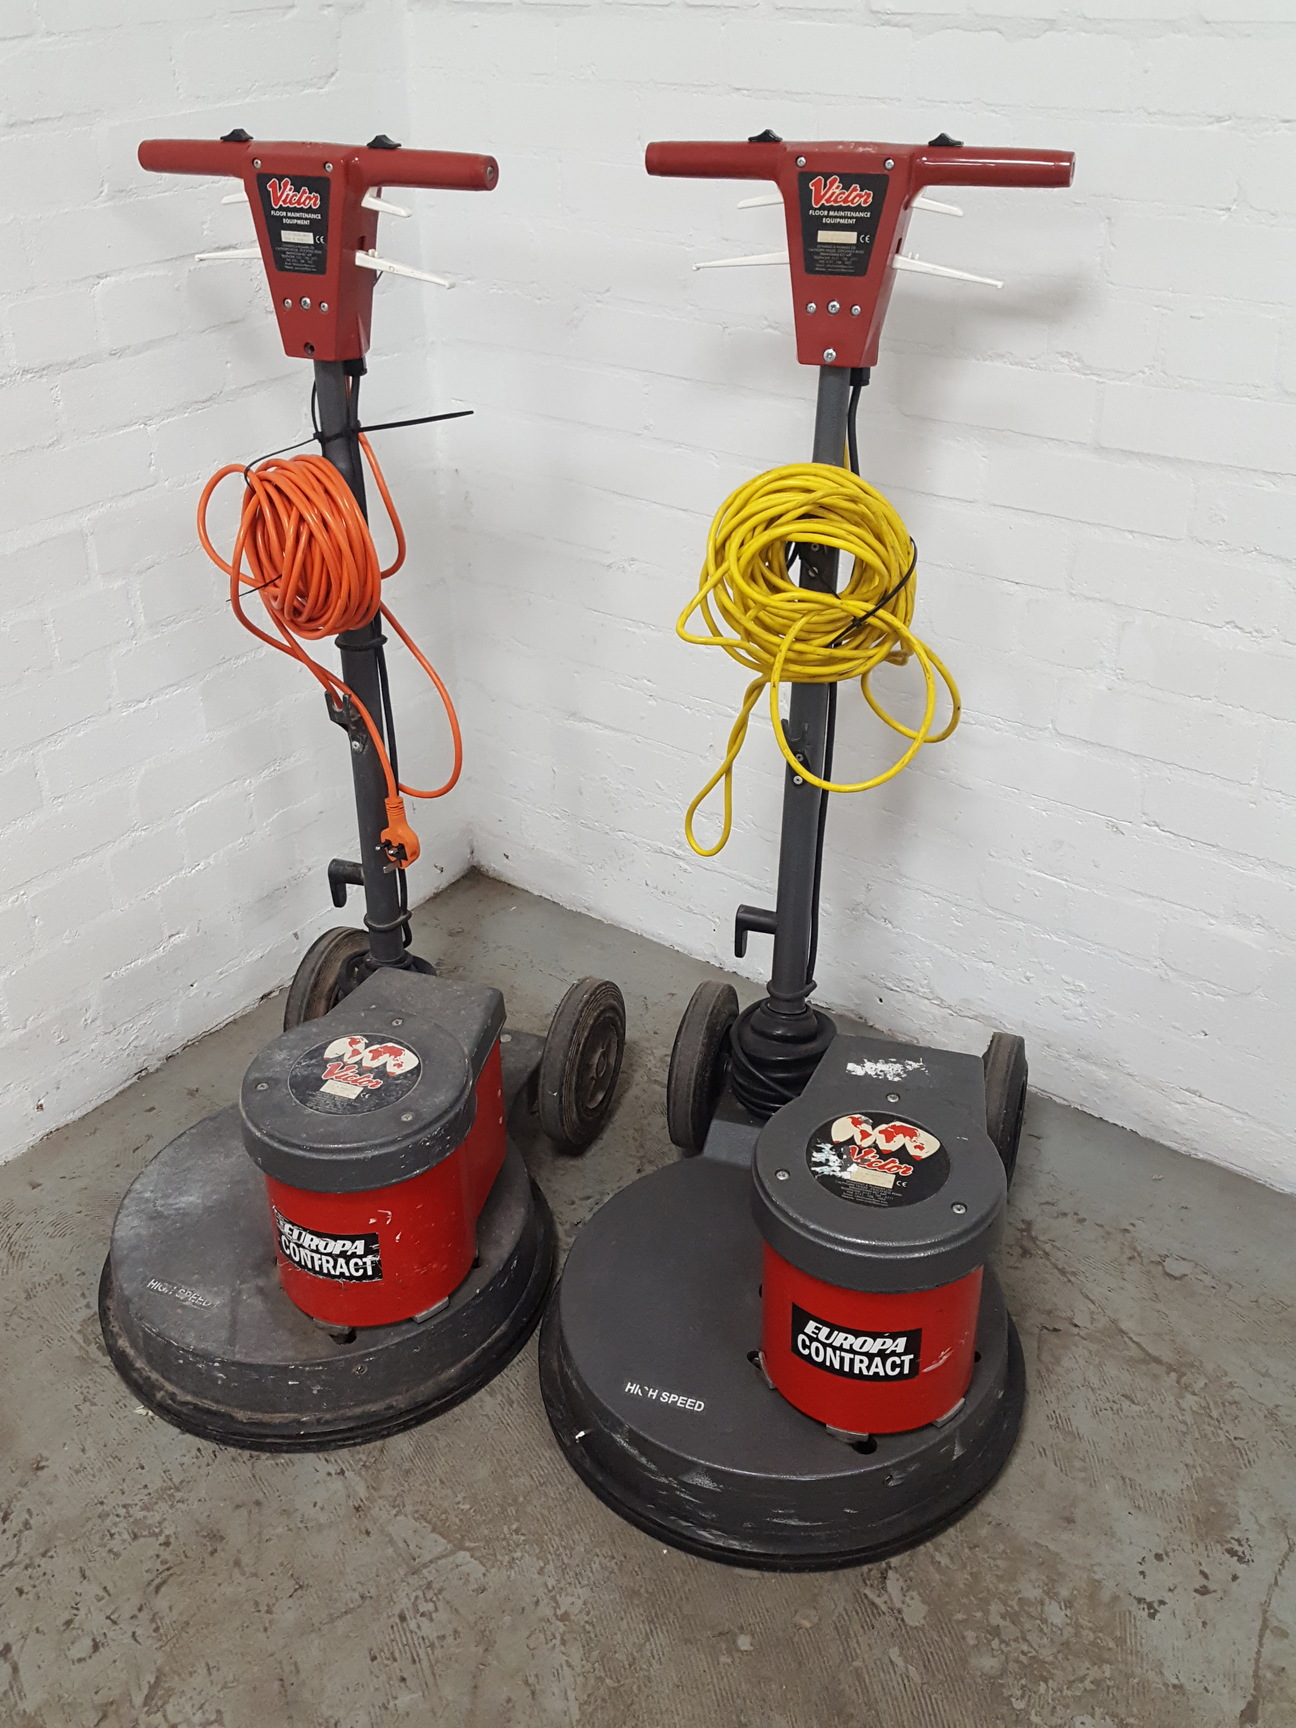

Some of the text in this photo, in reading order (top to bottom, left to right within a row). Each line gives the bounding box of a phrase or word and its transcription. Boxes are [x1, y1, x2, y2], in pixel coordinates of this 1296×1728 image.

[267, 178, 320, 209] Victor
[809, 175, 873, 208] Victor
[287, 211, 321, 219] MAINTENANCE
[829, 210, 870, 218] MAINTENANCE
[322, 1061, 383, 1090] Victor
[849, 1145, 914, 1176] Victor
[283, 1222, 365, 1255] EUROPA
[281, 1234, 376, 1277] CONTRACT
[803, 1320, 907, 1354] EUROPA
[797, 1333, 914, 1376] CONTRACT
[659, 1391, 705, 1412] SPEED
